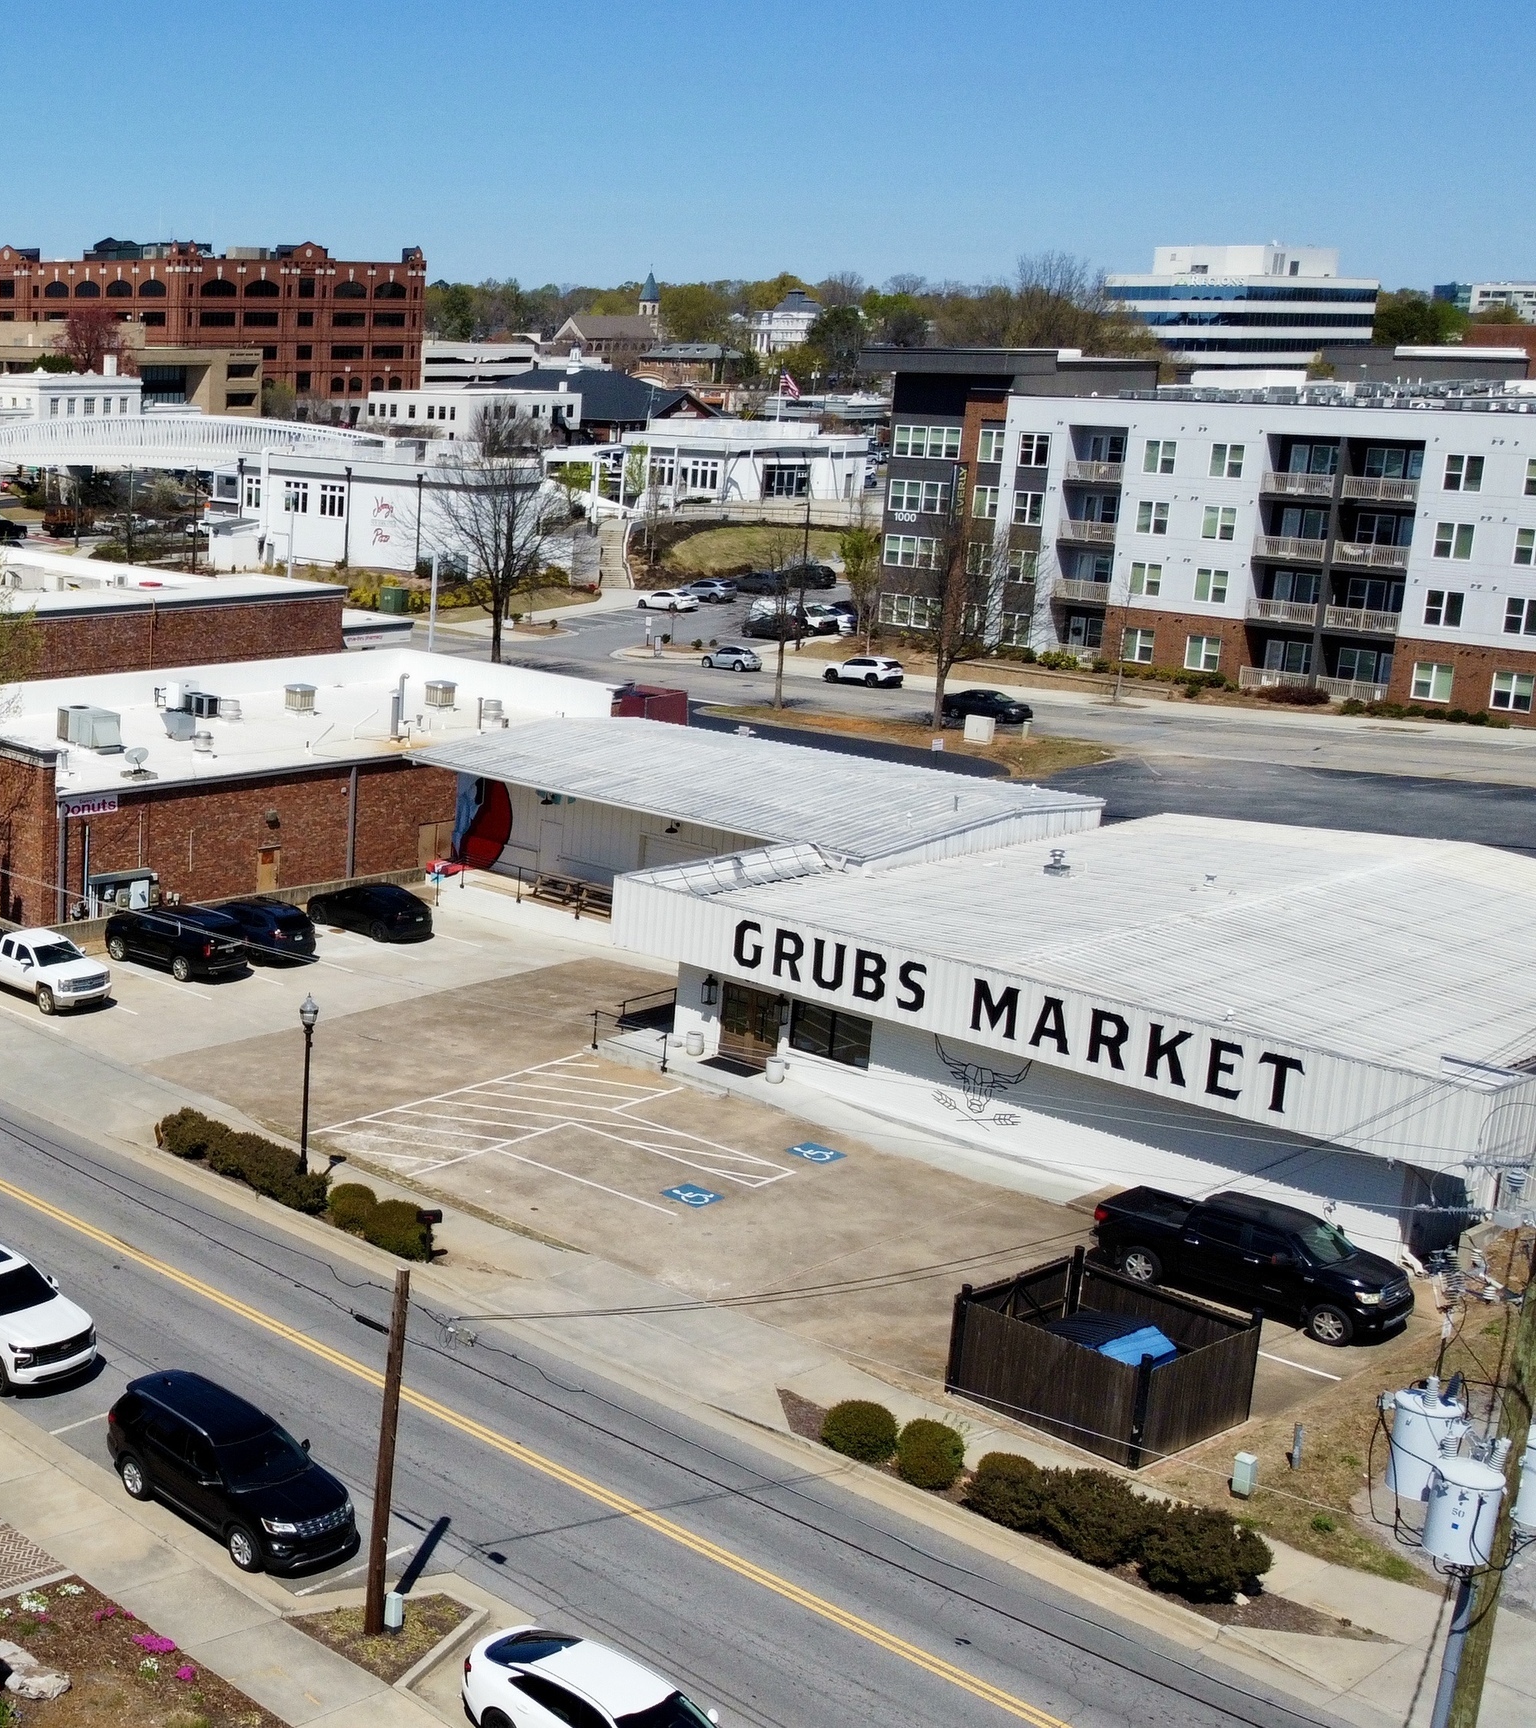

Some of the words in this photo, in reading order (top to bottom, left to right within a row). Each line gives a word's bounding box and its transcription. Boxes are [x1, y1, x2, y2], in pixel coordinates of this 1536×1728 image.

[955, 466, 967, 516] EVERLY
[894, 512, 917, 522] 1000
[733, 919, 927, 1013] GRUBS
[970, 978, 1306, 1114] MARKET
[1451, 1507, 1465, 1518] 50
